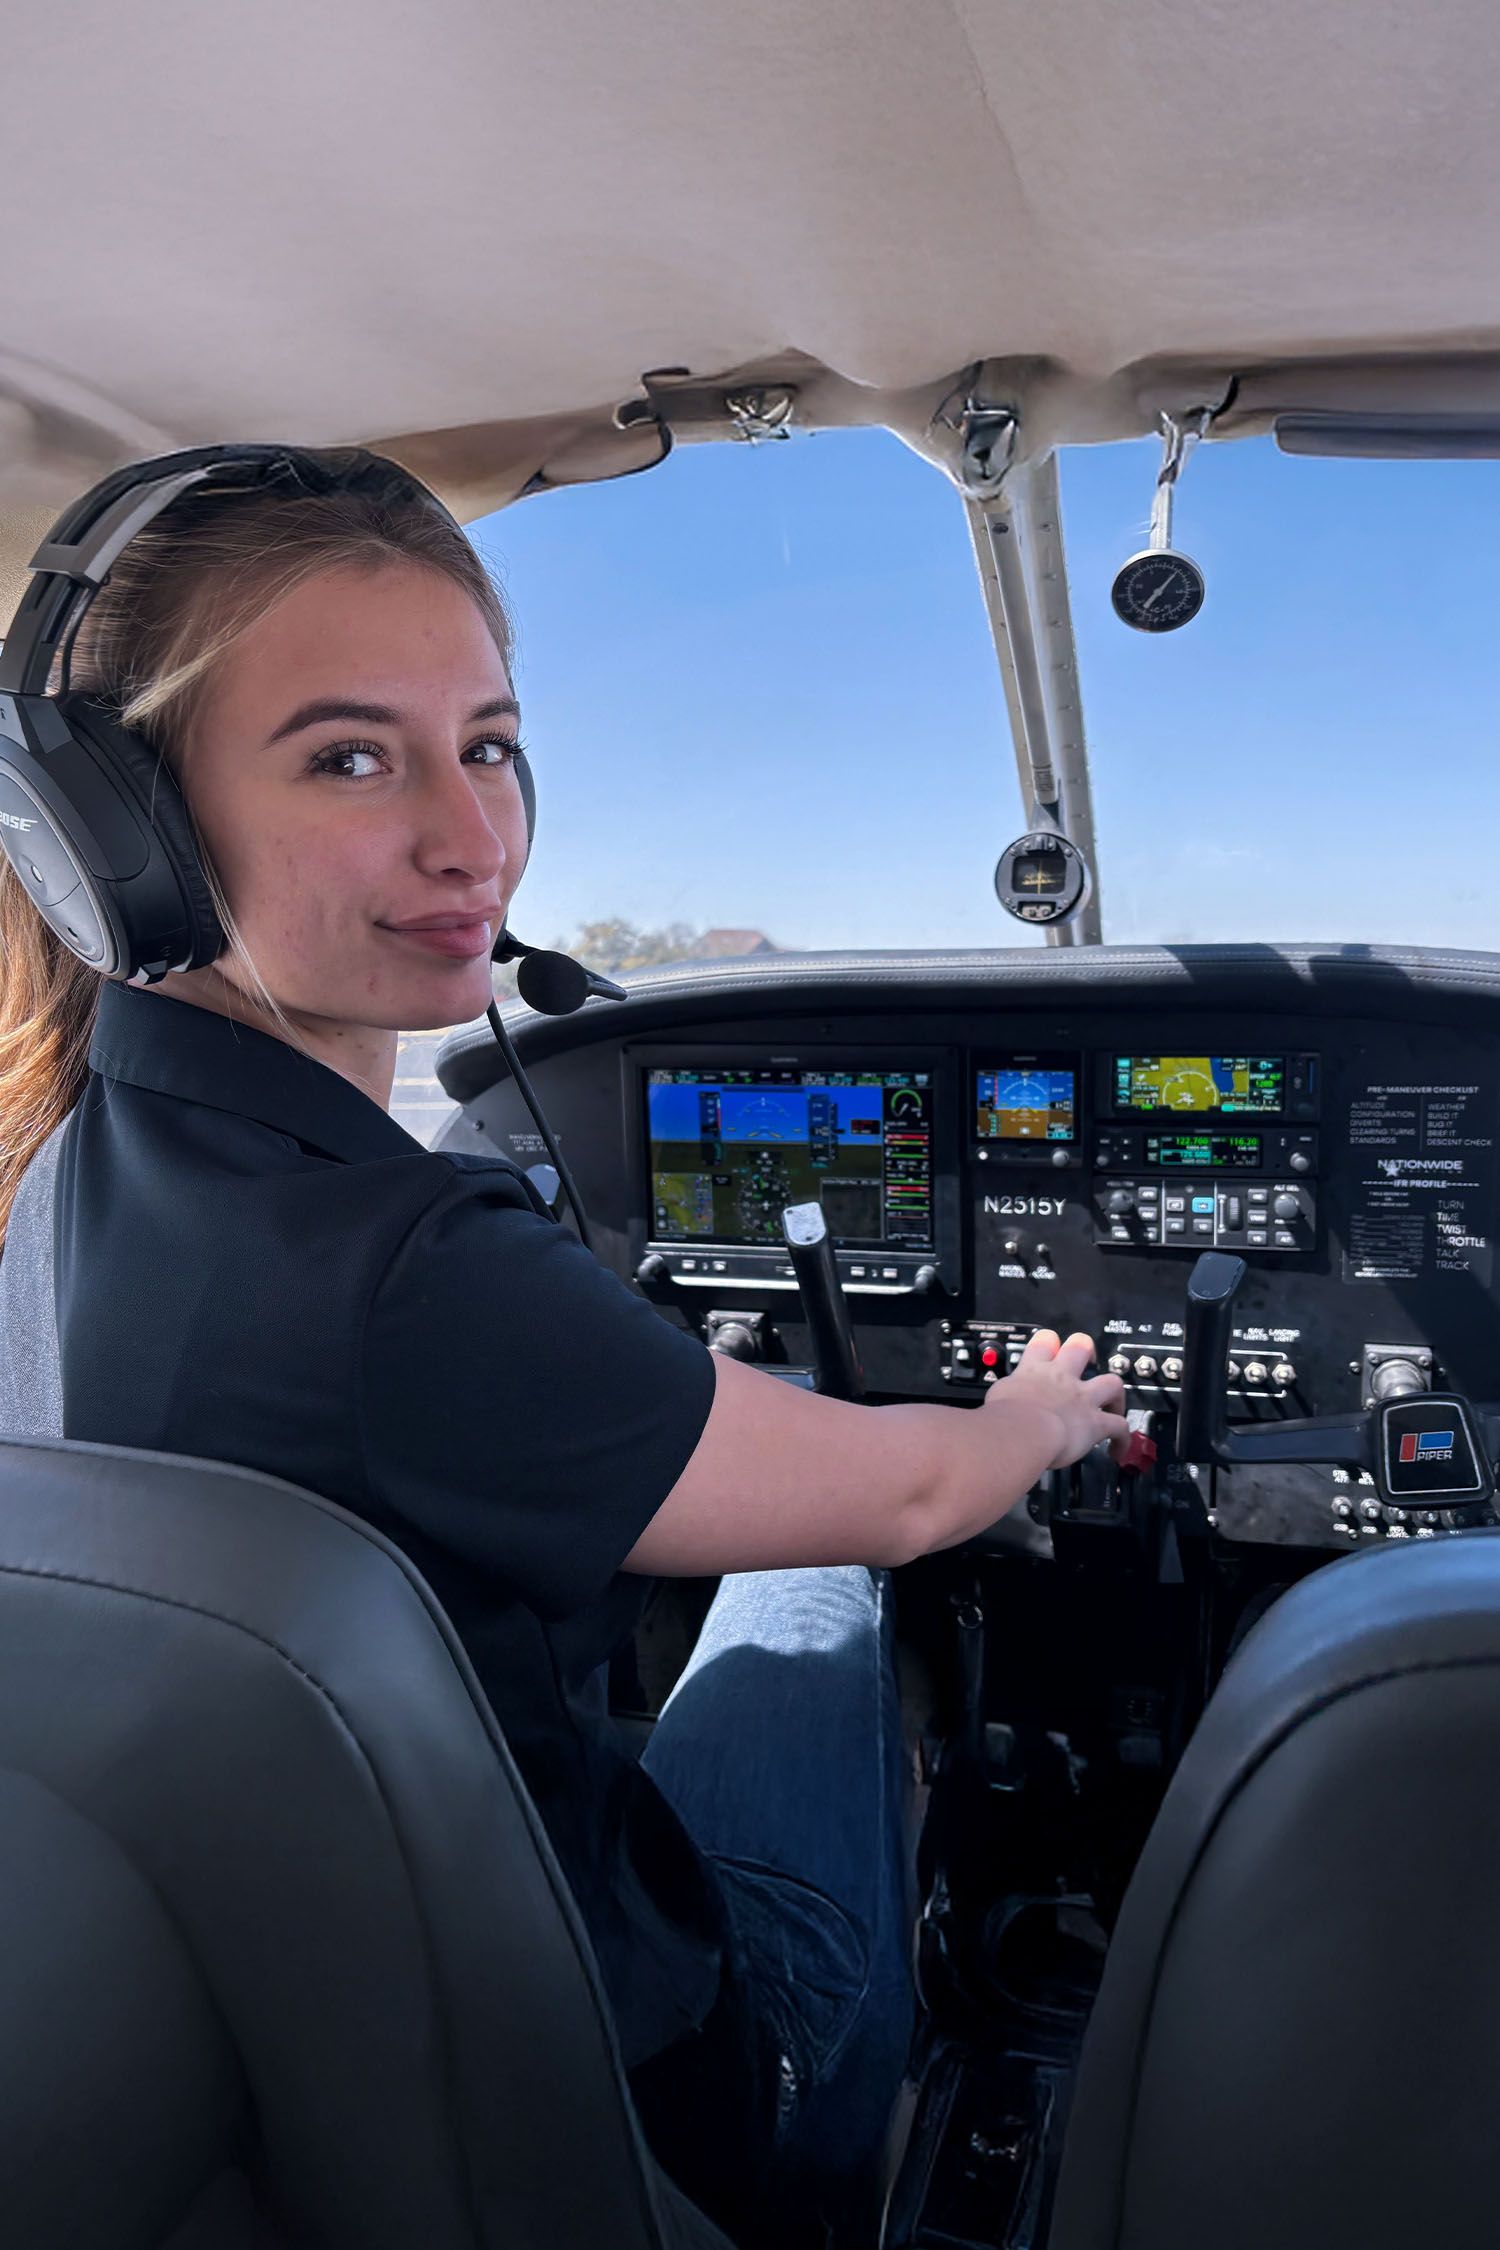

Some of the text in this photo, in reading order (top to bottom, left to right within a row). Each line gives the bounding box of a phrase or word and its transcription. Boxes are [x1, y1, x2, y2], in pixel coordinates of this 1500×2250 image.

[0, 811, 38, 832] OSE
[1367, 1086, 1479, 1094] PRE-MANEUVER CHECKLIST
[1350, 1102, 1385, 1110] ALTITUDE
[1428, 1103, 1465, 1111] WEATHER
[1350, 1110, 1415, 1118] CONFIGURATION
[1427, 1112, 1458, 1120] BUILD IT
[1350, 1128, 1416, 1136] CLEARING TURNS
[1427, 1129, 1456, 1137] BRIEF IT
[1350, 1136, 1397, 1144] STANDARDS
[1426, 1138, 1492, 1146] DESCENT CHECK
[1377, 1159, 1463, 1171] NATIONWIDE
[1393, 1180, 1447, 1188] IFR PROFILE
[984, 1195, 1067, 1215] N2515Y
[1437, 1200, 1464, 1209] TURN
[1436, 1212, 1459, 1222] TIME
[1436, 1224, 1467, 1234] TWIST
[1436, 1236, 1486, 1247] THROTTLE
[1436, 1248, 1459, 1258] TALK
[1435, 1260, 1469, 1270] TRACK
[1138, 1324, 1152, 1332] ALT
[1268, 1328, 1300, 1337] LANDING
[1417, 1449, 1453, 1461] PIPER
